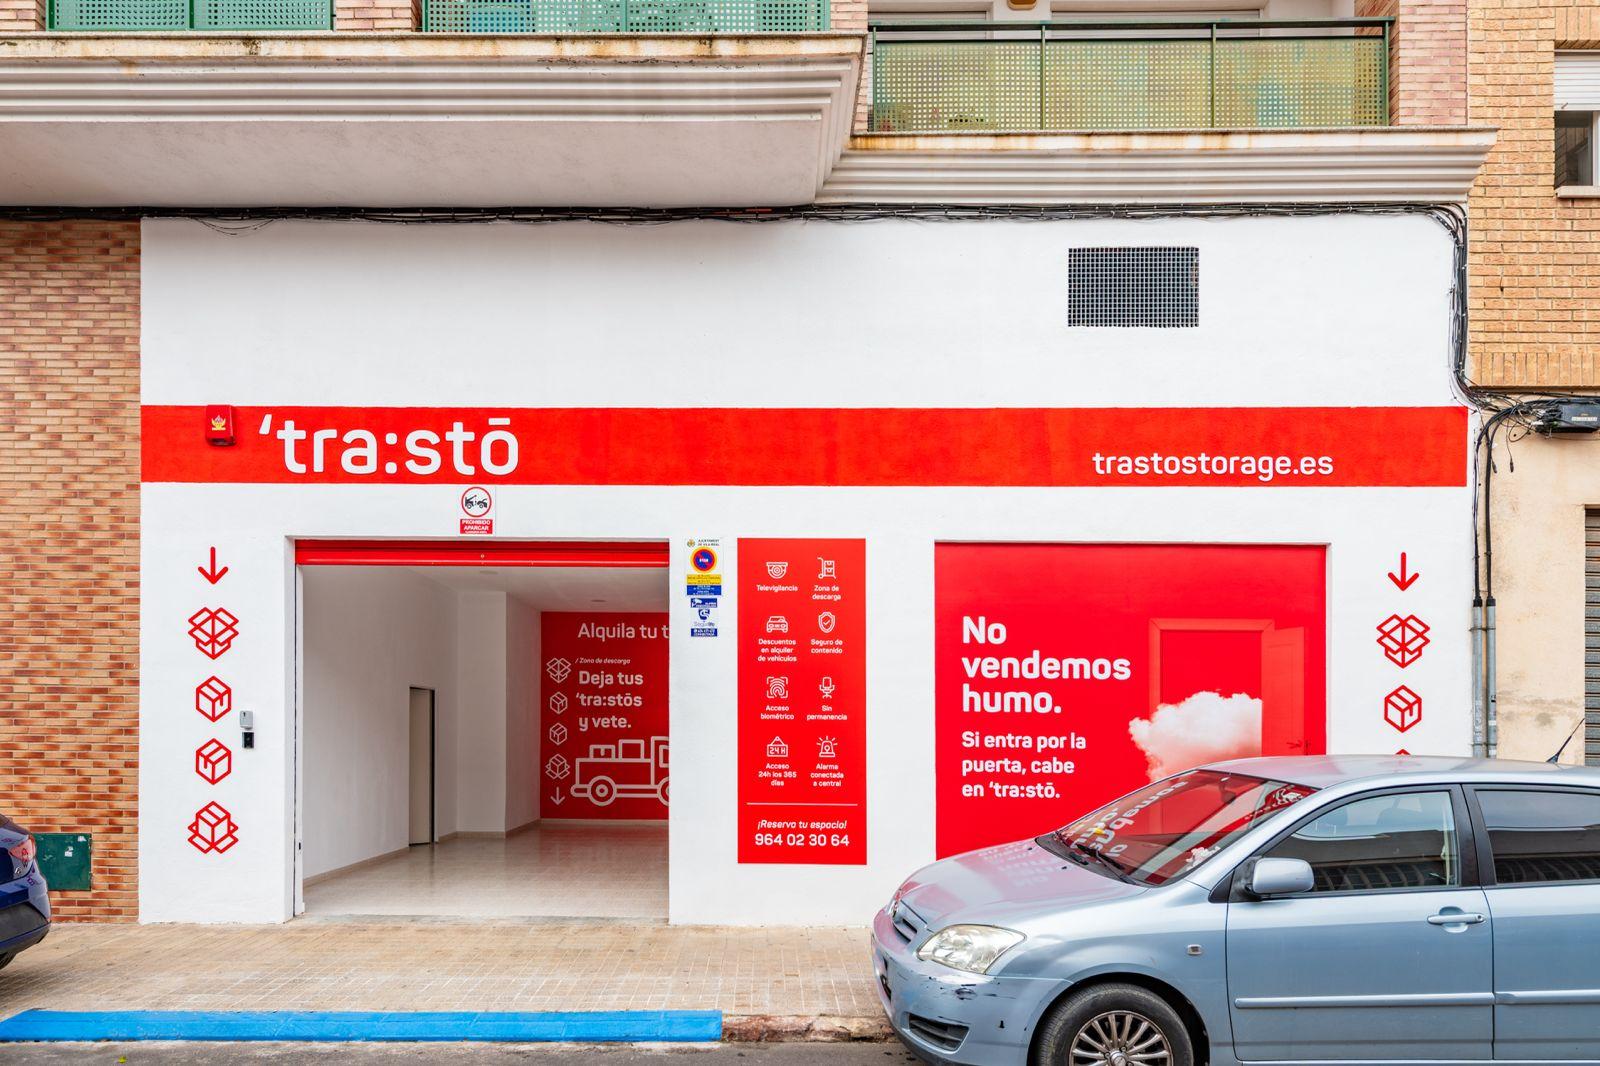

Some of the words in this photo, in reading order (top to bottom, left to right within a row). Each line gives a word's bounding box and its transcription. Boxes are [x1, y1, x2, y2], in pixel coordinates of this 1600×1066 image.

[1092, 452, 1333, 482] trastostorage.es
[578, 623, 635, 642] Alquila
[640, 625, 657, 638] tu
[963, 616, 1006, 644] No
[962, 650, 1131, 680] vendemos
[579, 671, 614, 688] Deja
[617, 673, 643, 685] tus
[963, 684, 1061, 713] humo.
[579, 717, 588, 731] y
[592, 716, 631, 728] vete.
[962, 731, 980, 747] Si
[984, 733, 1032, 748] entra
[1036, 736, 1067, 753] por
[1071, 732, 1086, 749] la
[962, 758, 1026, 776] puerta,
[1031, 757, 1074, 773] cabe
[962, 784, 984, 797] en
[758, 820, 796, 830] ¡Reserva
[810, 820, 847, 830] espacio!
[755, 834, 782, 846] 964
[787, 834, 804, 846] 02
[809, 834, 826, 846] 30
[831, 834, 849, 846] 64
